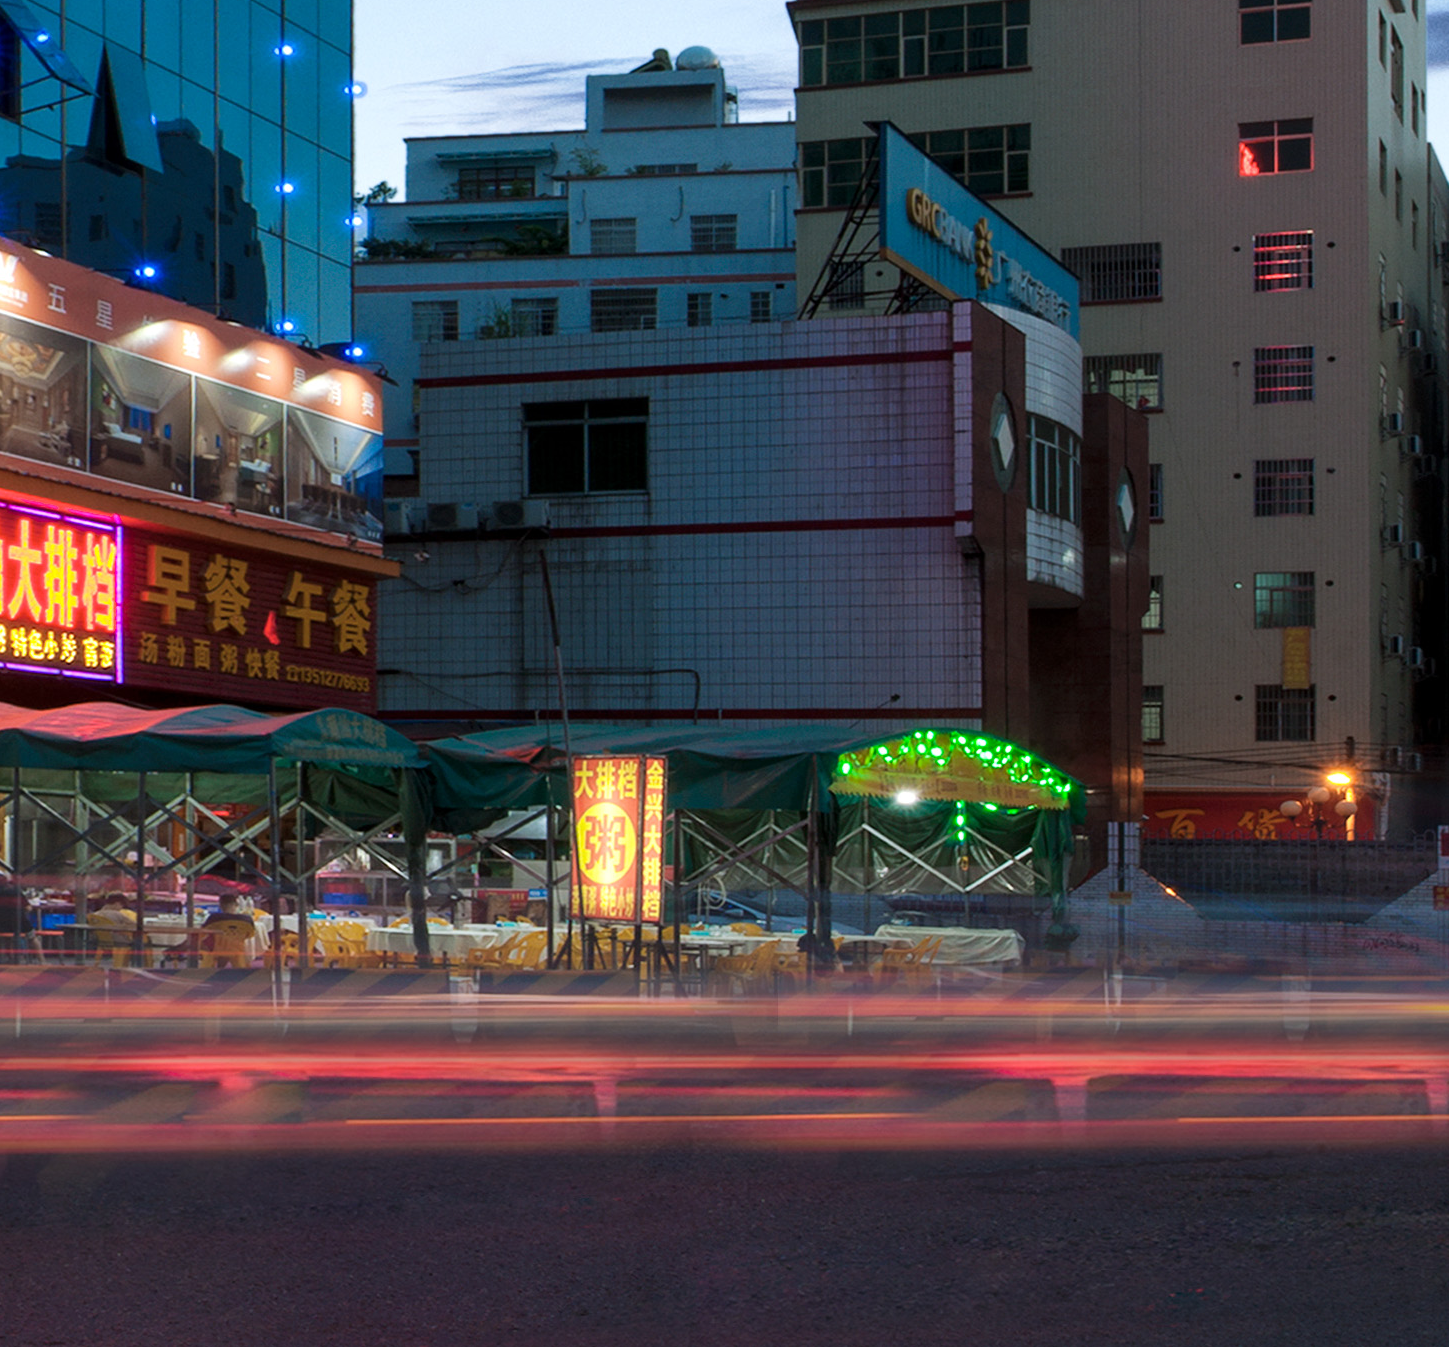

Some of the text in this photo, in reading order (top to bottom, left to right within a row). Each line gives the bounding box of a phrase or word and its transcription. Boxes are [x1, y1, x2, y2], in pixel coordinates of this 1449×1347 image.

[139, 544, 372, 656] 早餐 午餐
[574, 760, 638, 800] 大排档
[585, 814, 627, 874] 粥
[641, 759, 665, 919] 金兴大排档
